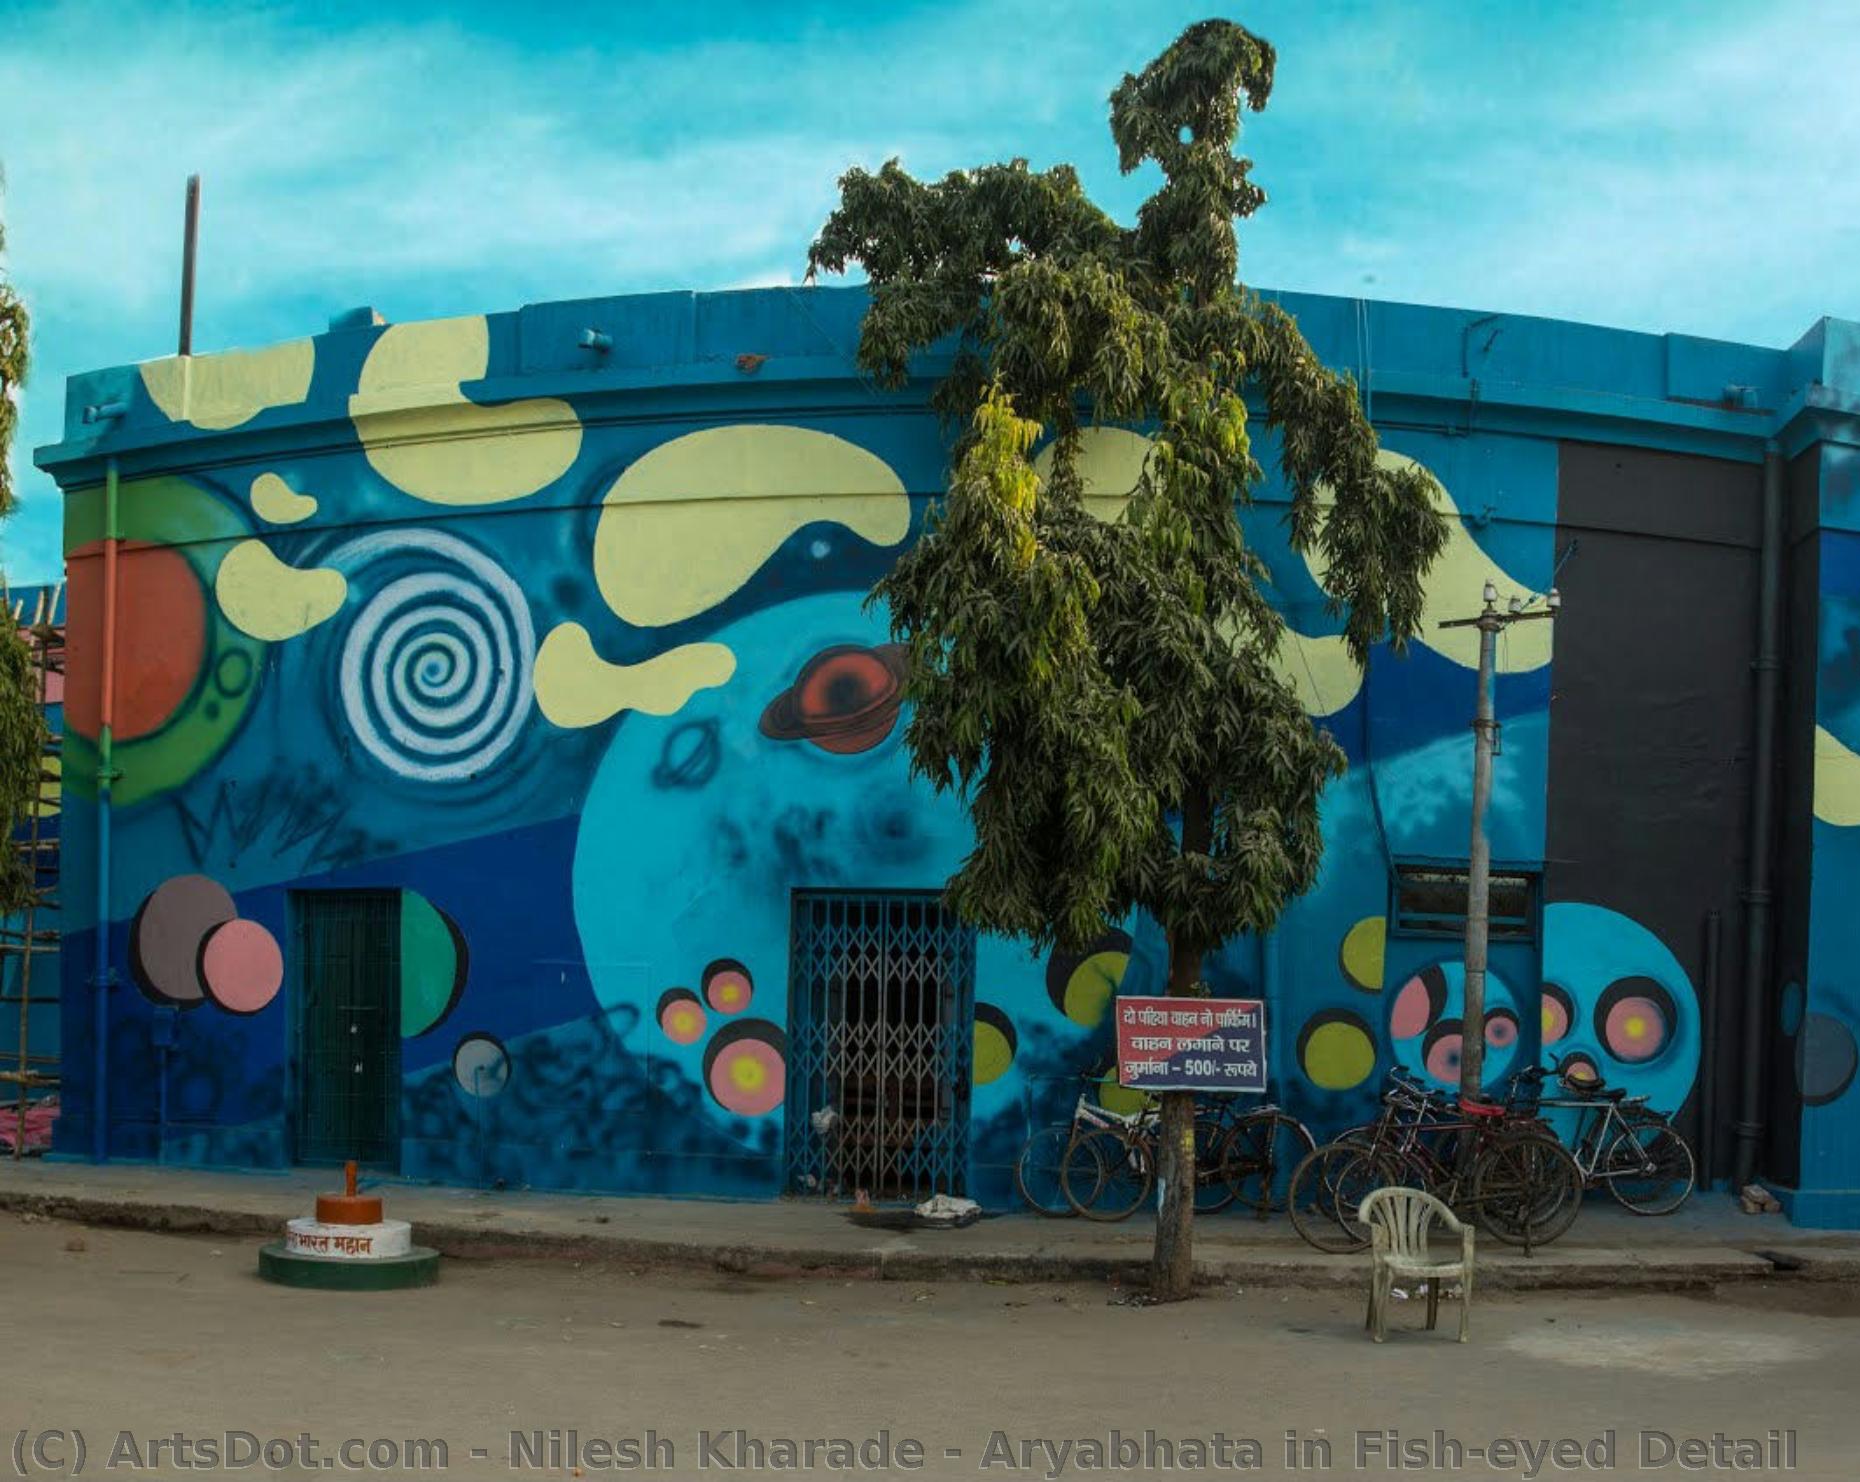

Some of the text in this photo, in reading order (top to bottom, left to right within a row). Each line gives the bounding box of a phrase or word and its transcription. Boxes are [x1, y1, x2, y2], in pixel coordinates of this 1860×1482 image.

[1123, 1006, 1136, 1024] दो
[1171, 1011, 1198, 1027] वाहन
[1200, 1008, 1213, 1027] नो
[1130, 1035, 1250, 1053] वाहन लगाने पर
[299, 1234, 329, 1253] भारत
[333, 1236, 373, 1254] महान
